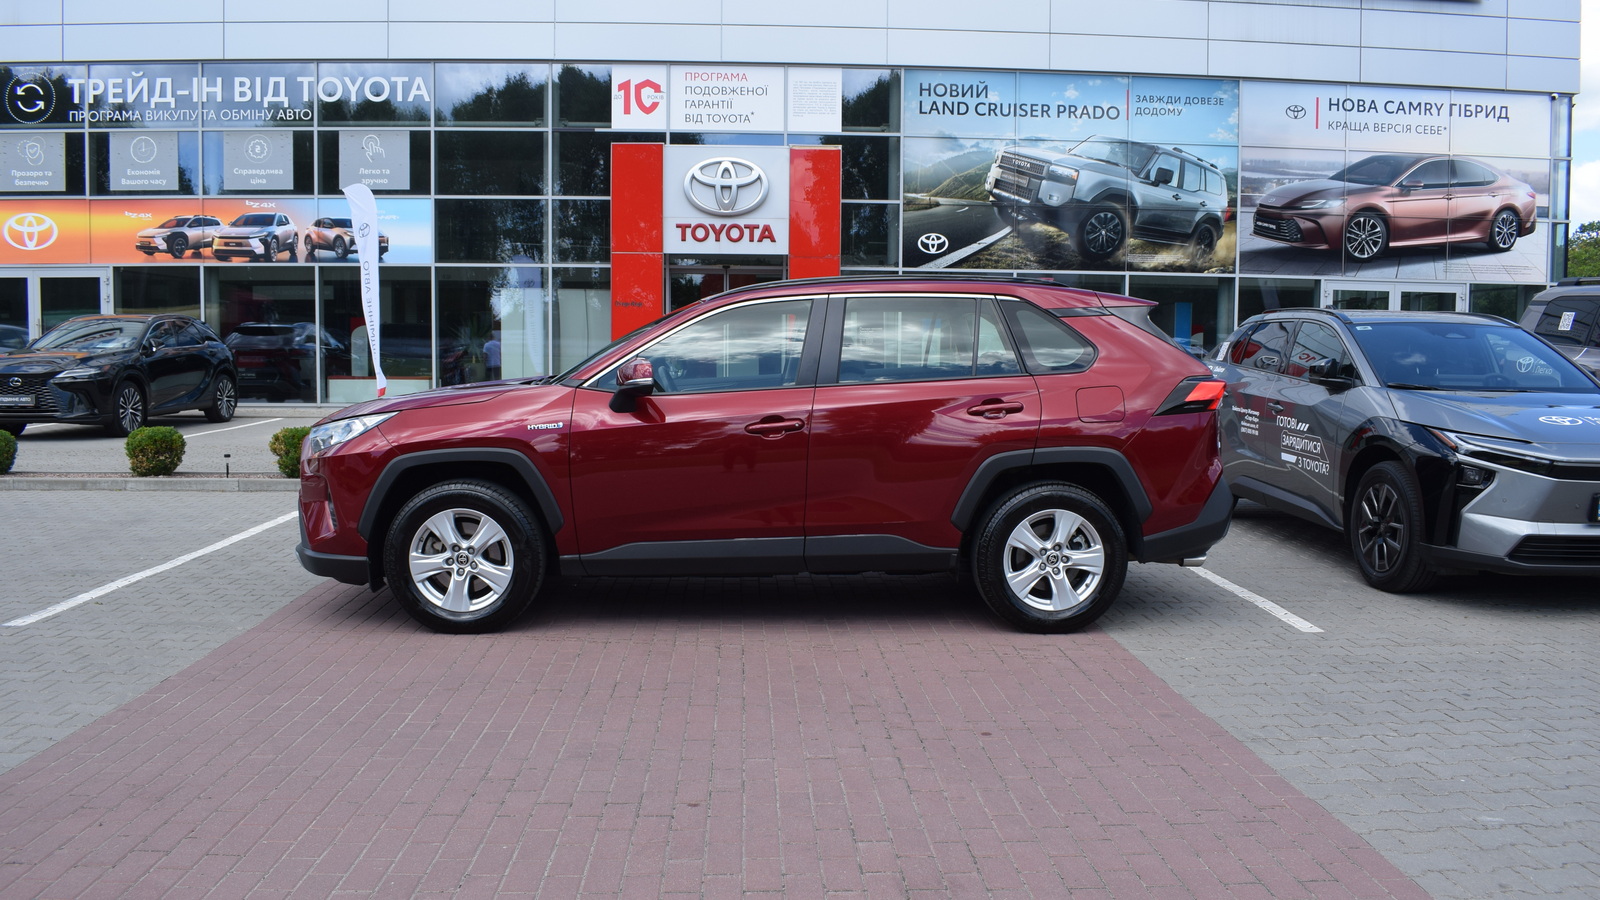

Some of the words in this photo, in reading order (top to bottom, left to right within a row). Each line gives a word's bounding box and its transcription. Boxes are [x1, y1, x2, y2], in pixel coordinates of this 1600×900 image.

[684, 72, 748, 82] ПРОГРАМА
[67, 71, 223, 109] ТРЕЙД-ІН
[234, 76, 289, 108] ВІД
[297, 76, 431, 103] TOYOTA
[684, 84, 769, 97] ПОДОВЖЕНОЇ
[919, 80, 989, 99] НОВИЙ
[684, 97, 734, 109] ГАРАНТІЇ
[1135, 94, 1181, 105] ЗАВЖДИ
[1183, 96, 1224, 107] ДОВЕЗЕ
[69, 110, 142, 122] ПРОГРАМА
[145, 110, 198, 121] ВИКУПУ
[200, 110, 217, 121] ТА
[220, 109, 273, 121] ОБМІНУ
[276, 109, 312, 121] АВТО
[918, 101, 970, 116] LAND
[975, 102, 1051, 118] CRUISER
[1056, 104, 1120, 120] PRADO
[1134, 106, 1183, 117] ДОДОМУ
[1328, 97, 1379, 115] НОВА
[1383, 99, 1444, 118] CAMRY
[1448, 102, 1510, 123] ГІБРИД
[684, 113, 703, 124] ВІД
[1328, 120, 1370, 133] КРАЩА
[1373, 122, 1412, 135] ВЕРСІЯ
[1012, 159, 1031, 169] TOYOTA
[11, 170, 43, 178] Прозоро
[233, 168, 283, 176] Справедлива
[150, 179, 167, 187] часу
[250, 177, 267, 185] ціна
[675, 223, 777, 243] TOYOTA
[1282, 434, 1321, 453] ЗАРЯДИТИСЯ
[1297, 456, 1302, 468] З
[1303, 458, 1330, 475] TOYOTA?
